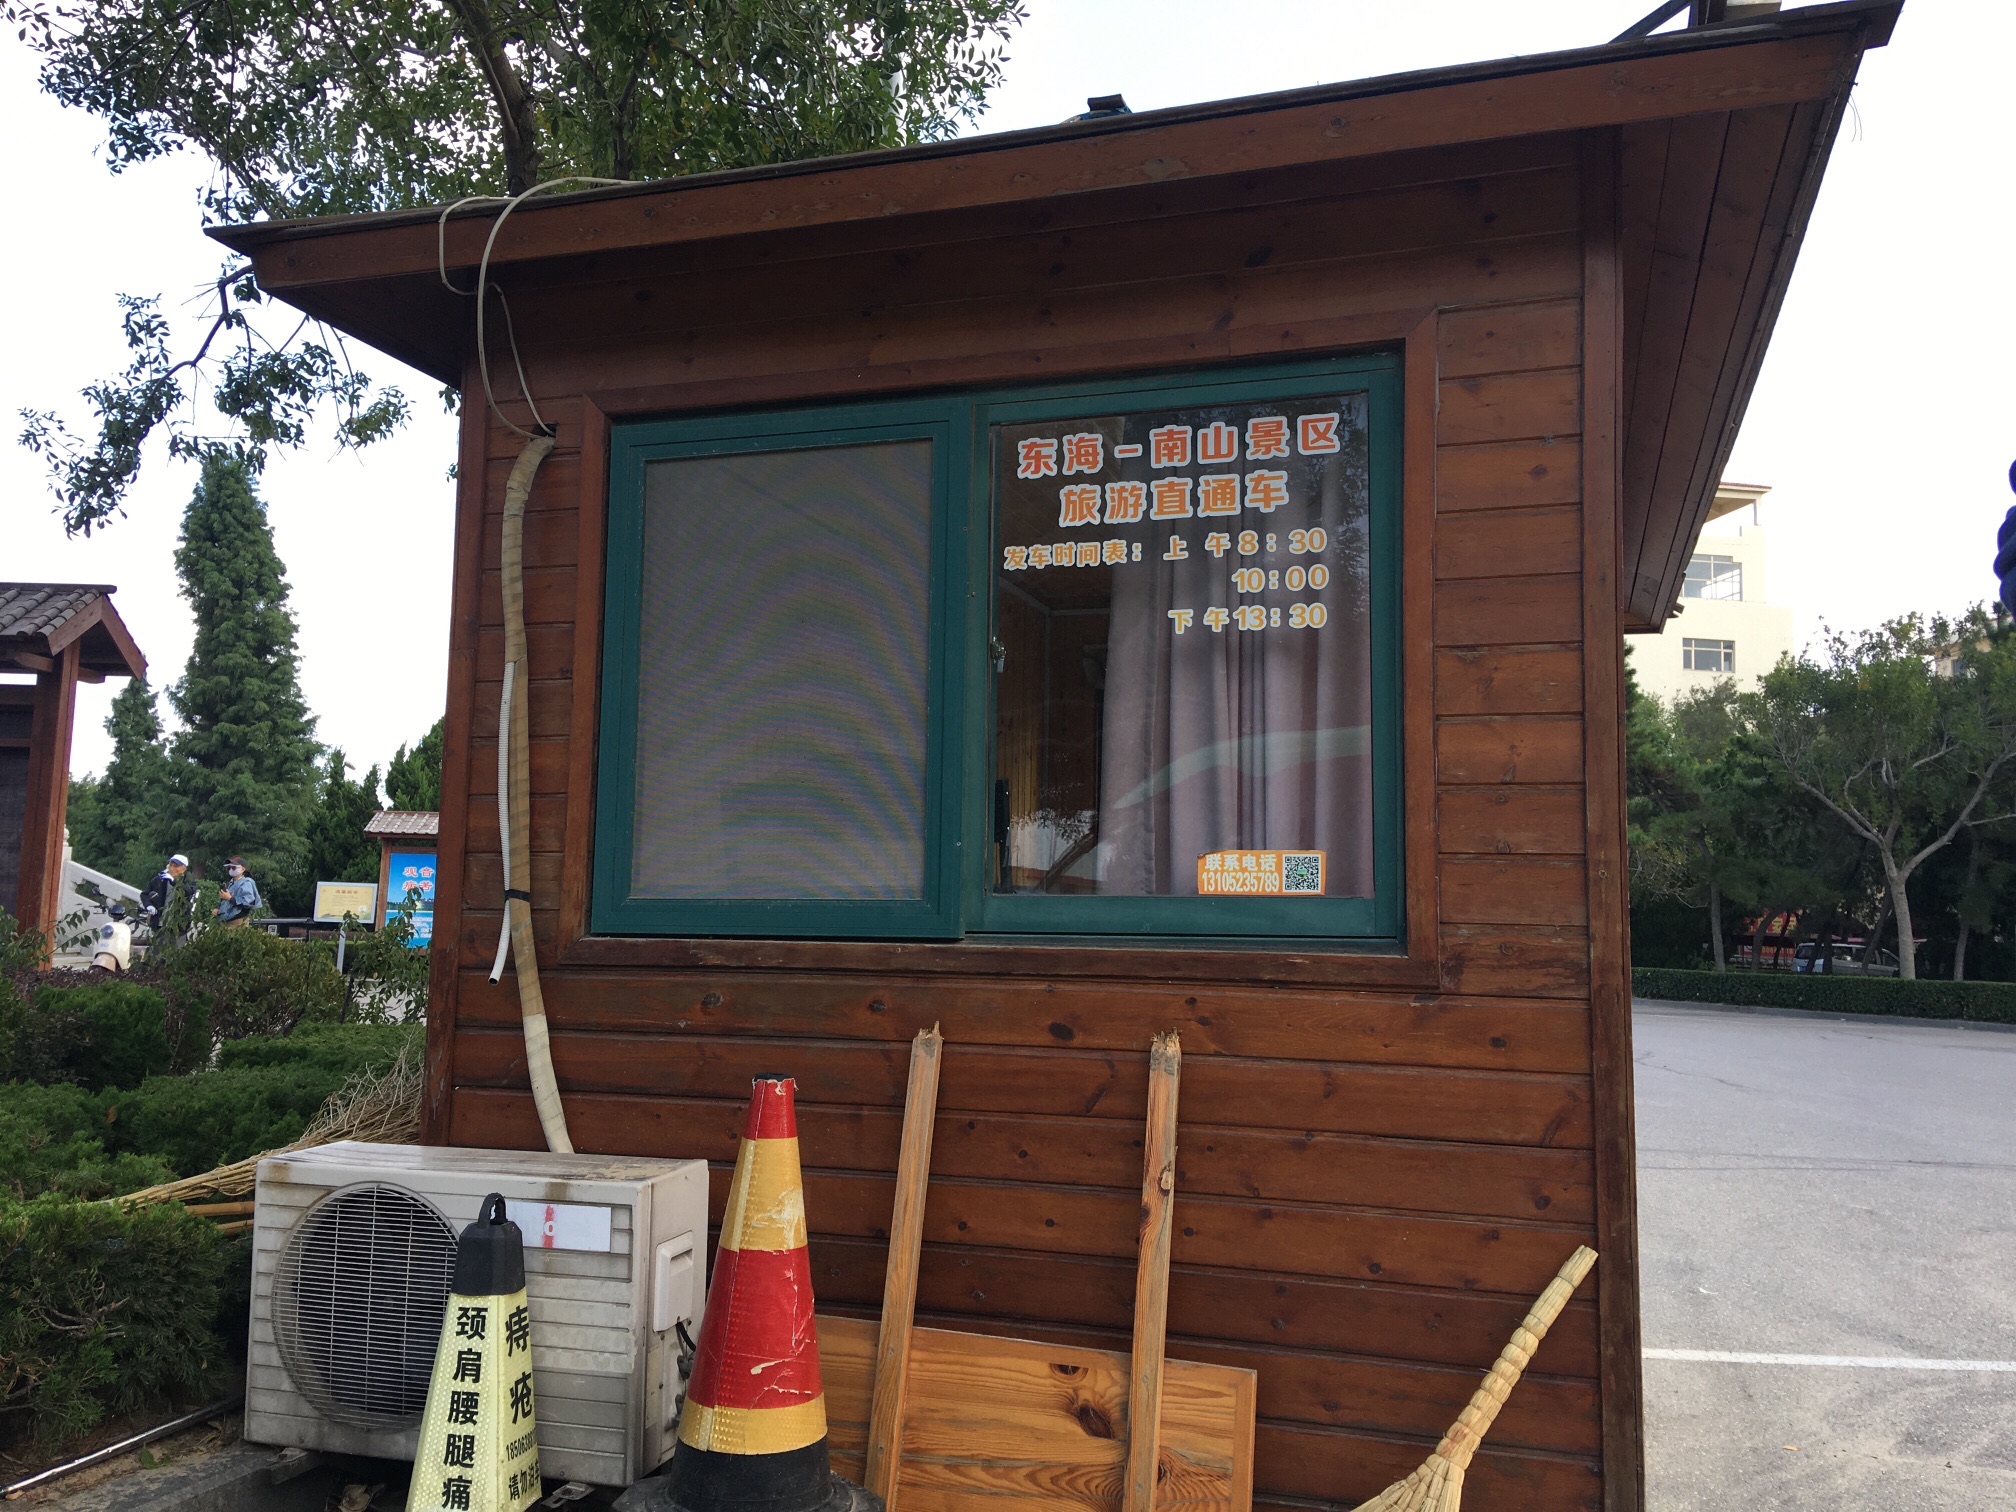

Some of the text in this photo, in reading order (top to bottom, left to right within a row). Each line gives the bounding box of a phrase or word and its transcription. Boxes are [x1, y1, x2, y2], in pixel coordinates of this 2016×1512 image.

[1058, 469, 1290, 528] 旅游直通车
[1201, 872, 1280, 893] 13105235789
[1204, 853, 1278, 872] 联系电话
[505, 1305, 533, 1425] 痔疮
[441, 1305, 489, 1512] 颈肩腰腿痛
